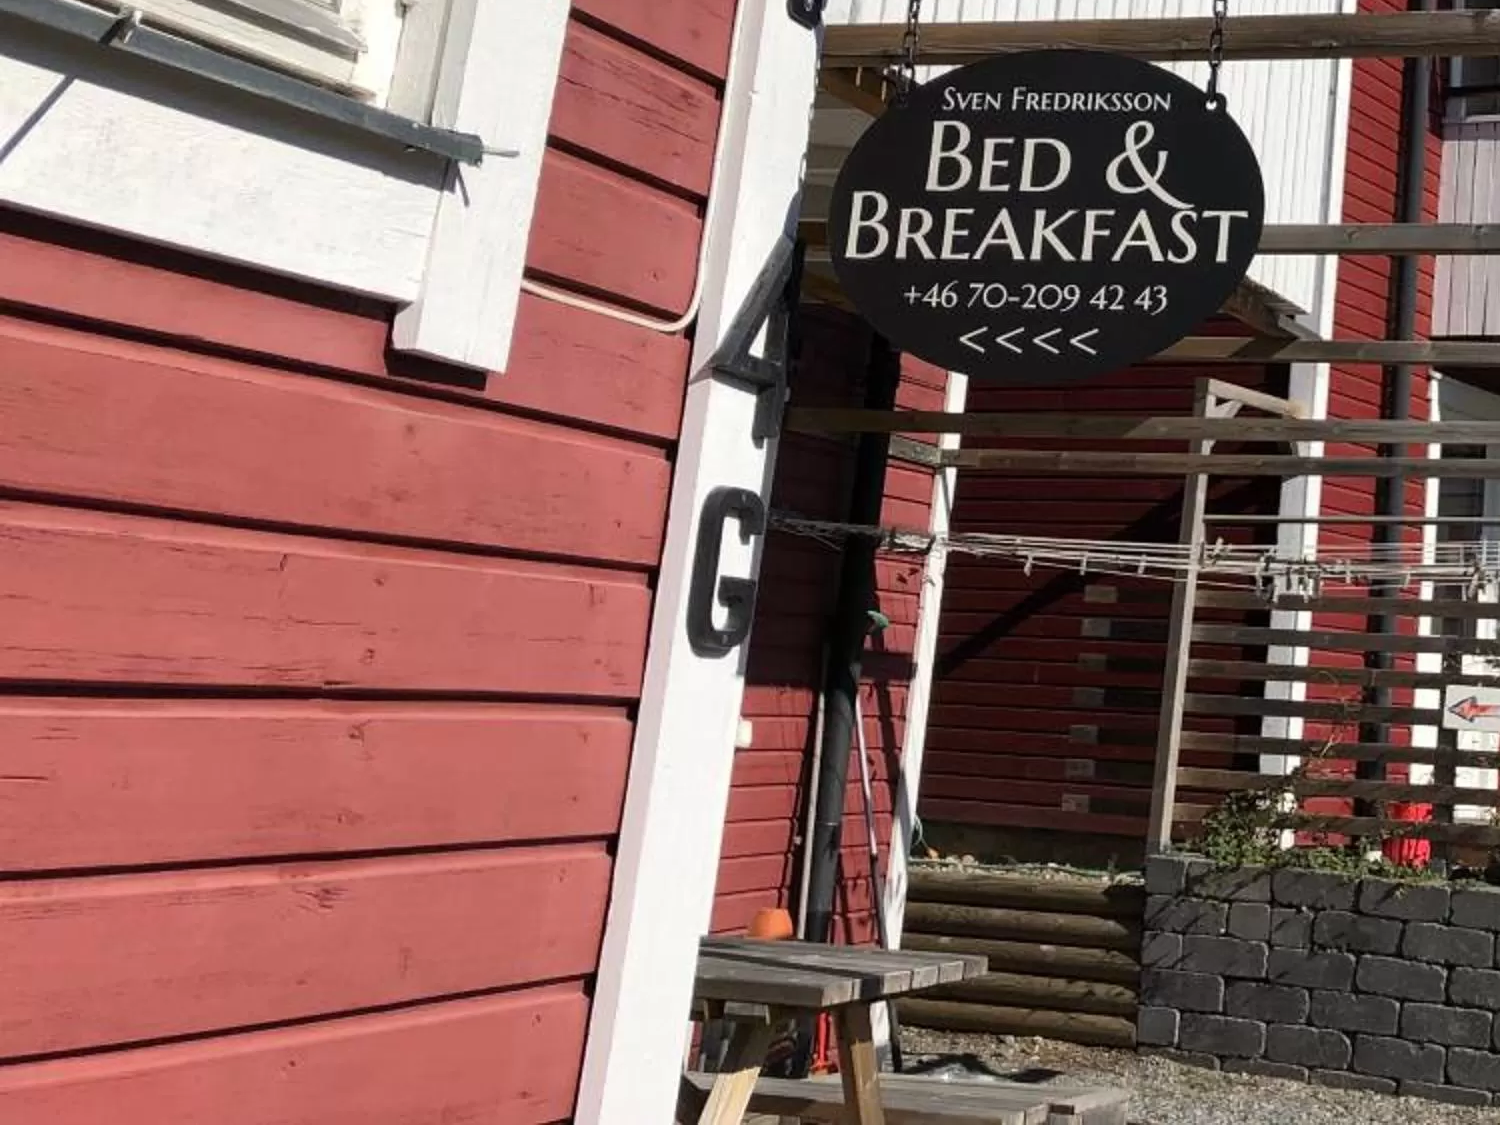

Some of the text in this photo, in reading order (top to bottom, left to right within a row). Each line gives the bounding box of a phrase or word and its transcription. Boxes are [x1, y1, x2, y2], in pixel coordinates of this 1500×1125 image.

[942, 86, 1171, 112] SVEN FREDRIKSSON
[925, 120, 1195, 210] BED &
[844, 190, 1249, 264] BREAKFAST
[904, 280, 1169, 316] +46 70-209 42 43
